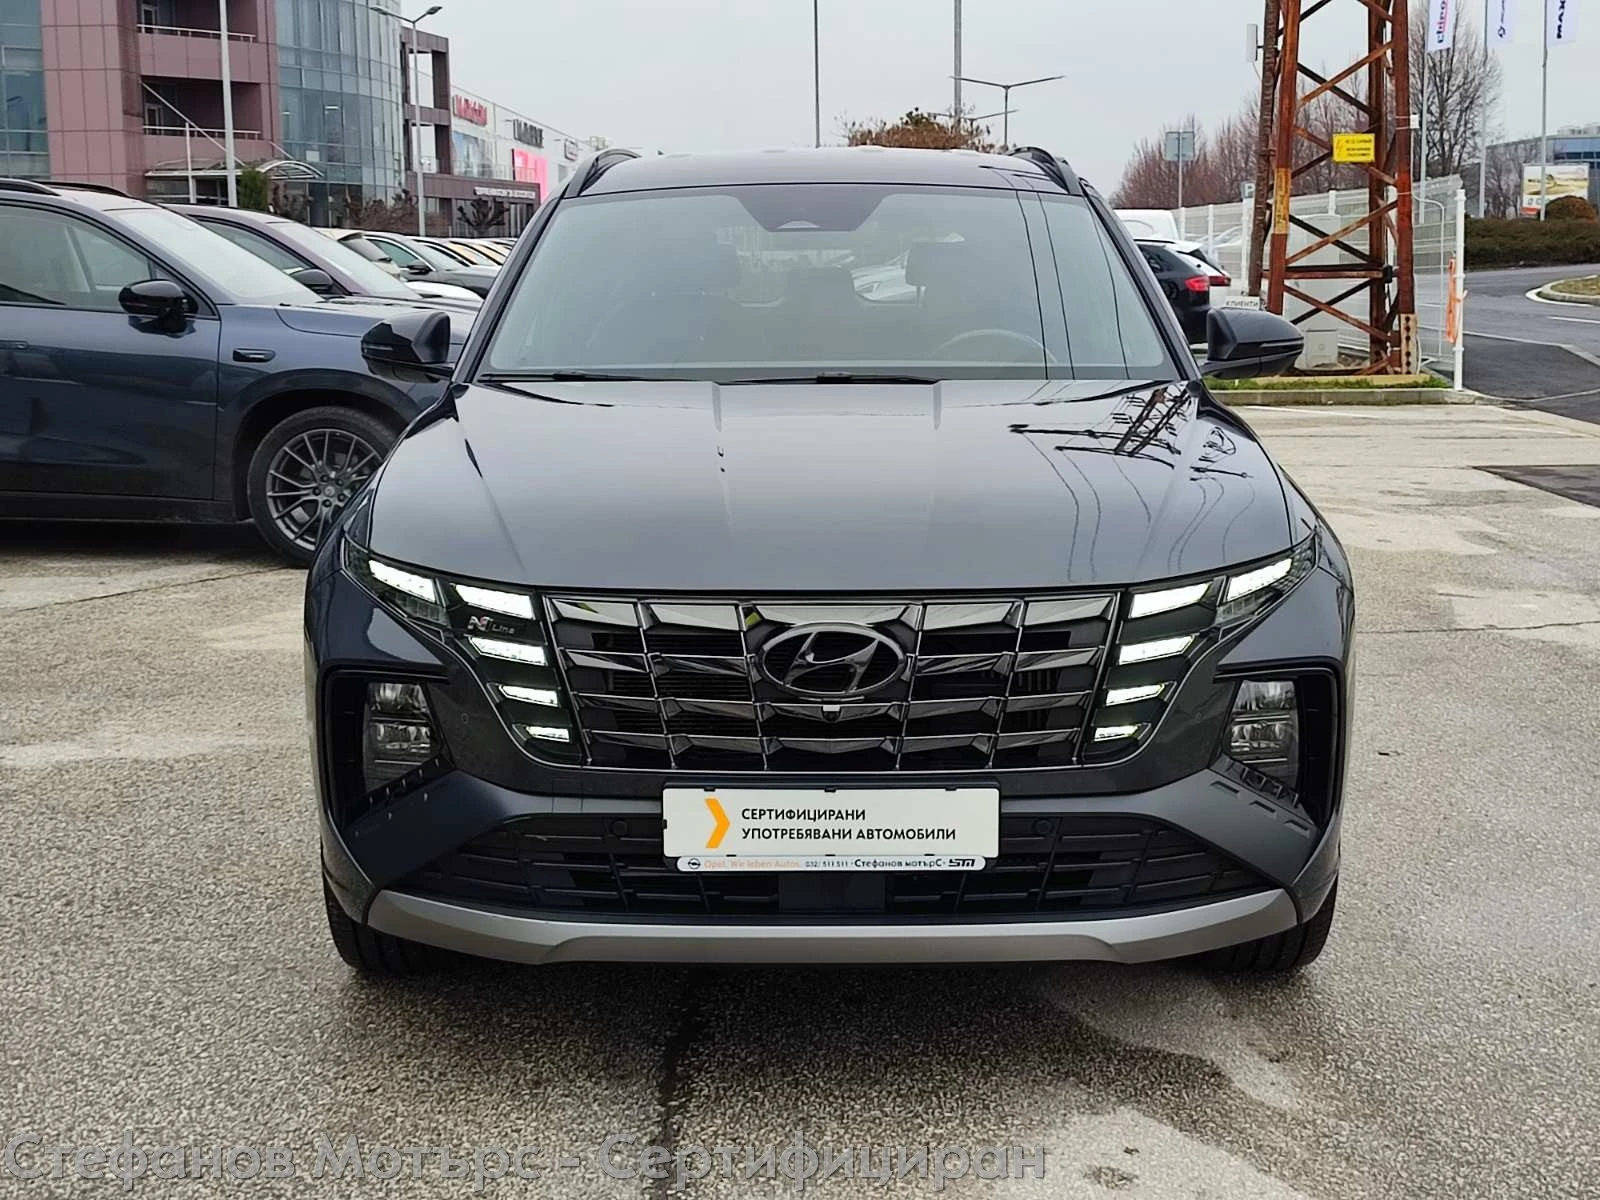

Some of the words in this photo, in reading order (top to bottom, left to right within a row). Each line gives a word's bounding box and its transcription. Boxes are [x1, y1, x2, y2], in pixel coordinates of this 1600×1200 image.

[741, 808, 866, 822] СЕРТИФИЦИРАНИ
[742, 828, 853, 840] УПОТРЕБЯВАНИ
[856, 828, 957, 840] АВТОМОБИЛИ
